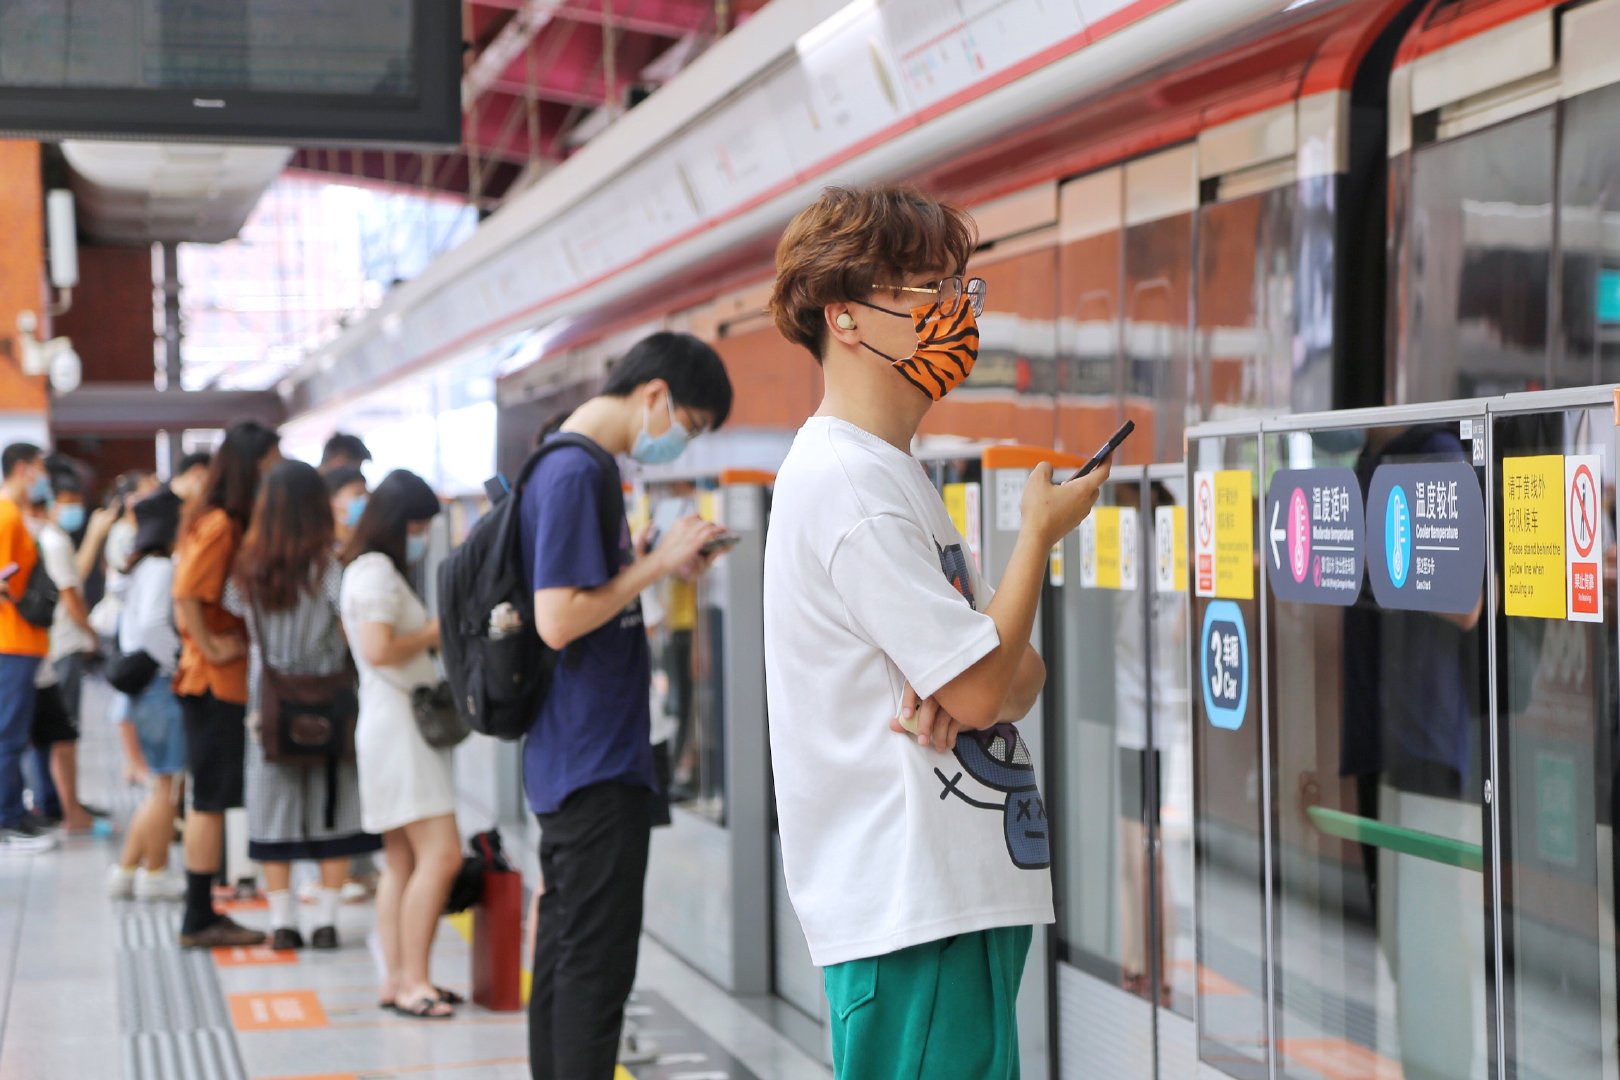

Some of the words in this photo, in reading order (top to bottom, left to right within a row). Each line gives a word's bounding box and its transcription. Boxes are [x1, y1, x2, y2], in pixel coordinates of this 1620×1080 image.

[1508, 474, 1546, 499] 请于黄线外
[1312, 486, 1349, 522] 温度适中
[1416, 481, 1458, 520] 温度较低
[1416, 524, 1430, 539] Cooler
[1431, 525, 1459, 542] temperature
[1508, 508, 1538, 533] 排队候车
[1331, 526, 1354, 543] temperature
[1509, 541, 1523, 554] Please
[1524, 542, 1536, 555] stand
[1537, 542, 1552, 555] behind
[1553, 543, 1561, 556] the
[1509, 562, 1522, 577] yellow
[1524, 562, 1532, 575] line
[1533, 562, 1545, 575] when
[1509, 581, 1527, 598] queuing
[1528, 585, 1534, 598] up
[1211, 630, 1223, 697] 3
[1223, 671, 1237, 699] Car
